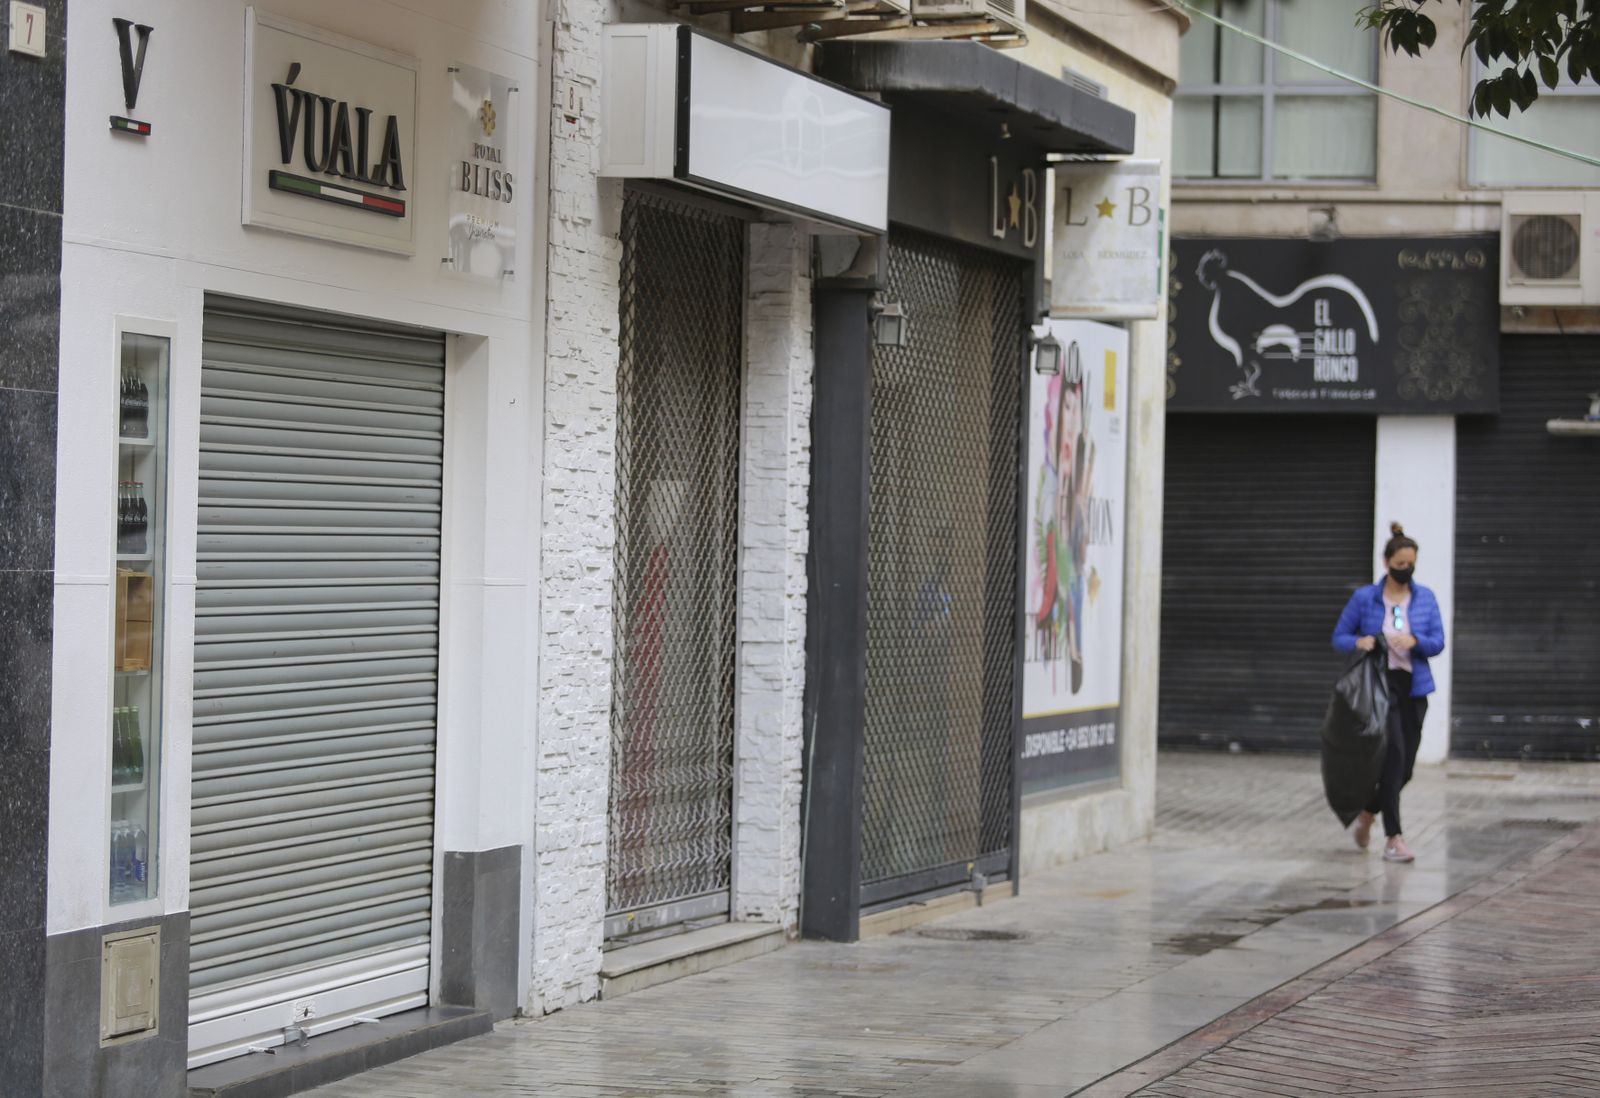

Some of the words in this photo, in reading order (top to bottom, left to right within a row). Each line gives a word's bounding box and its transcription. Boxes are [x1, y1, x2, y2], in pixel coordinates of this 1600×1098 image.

[26, 13, 34, 45] 7
[112, 17, 154, 109] V
[473, 142, 502, 164] ROYAL
[461, 160, 513, 204] BLISS
[991, 156, 1007, 239] L
[1022, 168, 1038, 249] B
[1062, 186, 1088, 227] L
[1125, 186, 1152, 227] B
[1314, 299, 1332, 326] EL
[1314, 328, 1356, 355] GALLO
[1313, 355, 1358, 382] RONCO
